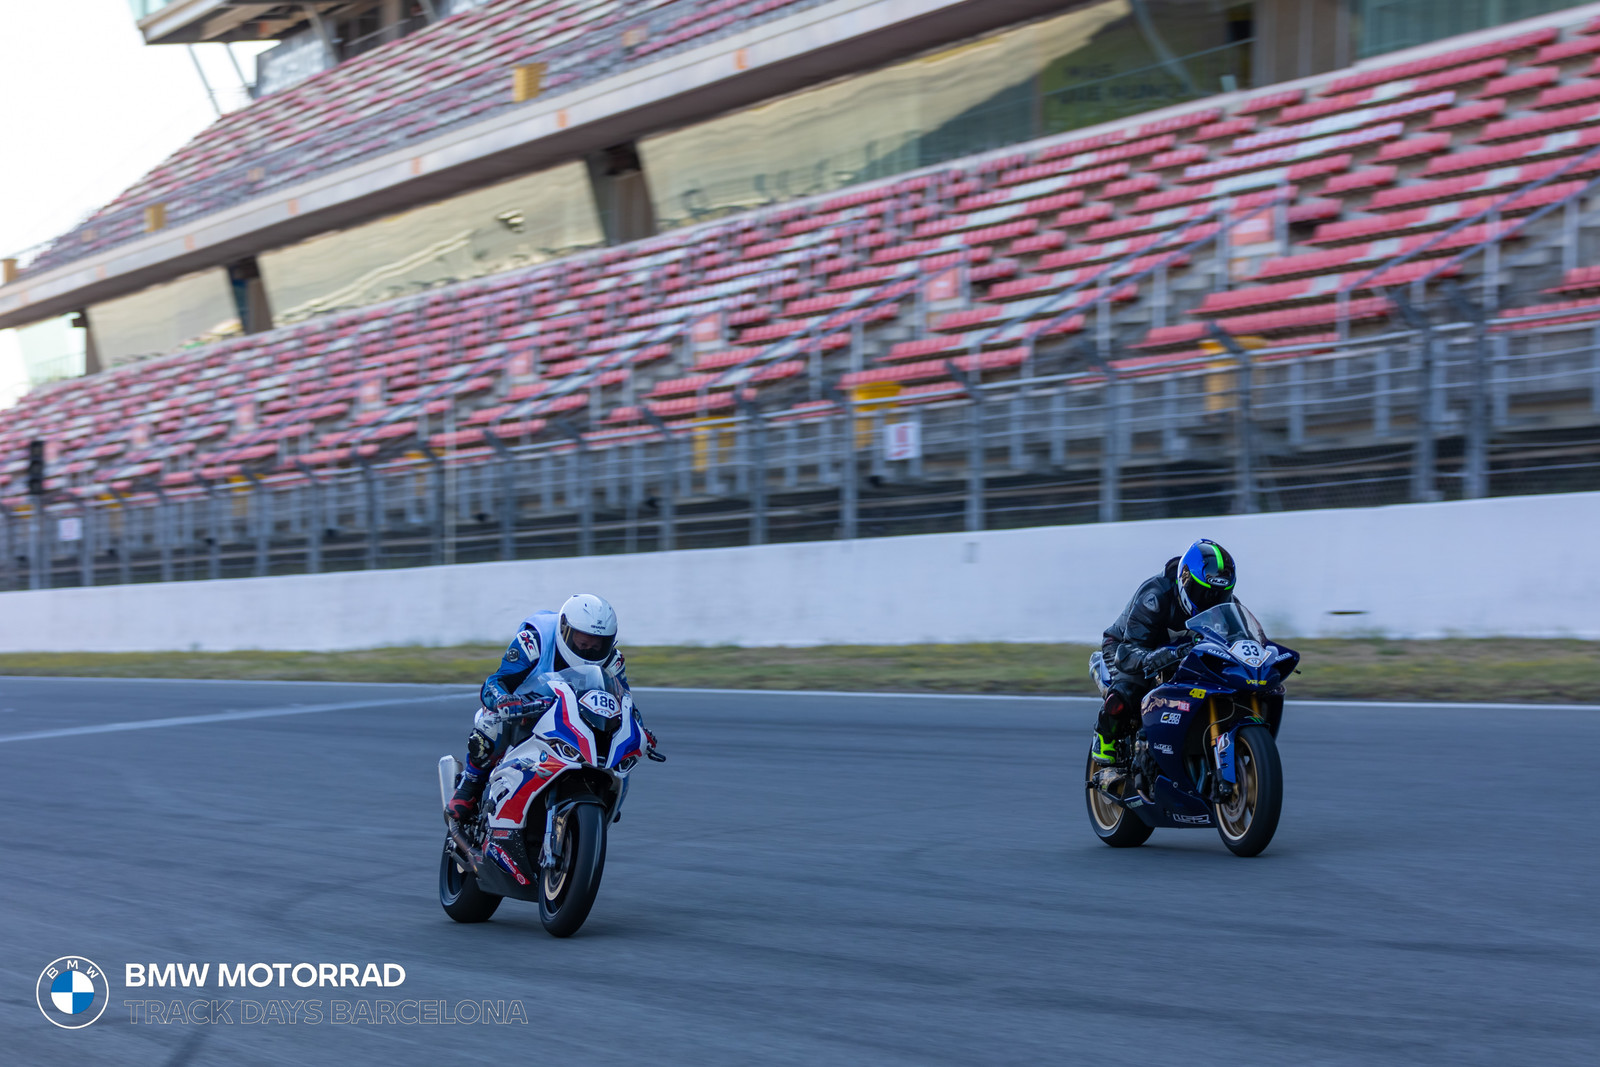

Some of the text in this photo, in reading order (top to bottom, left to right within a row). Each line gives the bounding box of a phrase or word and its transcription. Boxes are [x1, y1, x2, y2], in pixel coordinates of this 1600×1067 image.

[1241, 645, 1260, 656] 33
[1189, 688, 1207, 699] 46
[590, 694, 616, 712] 186
